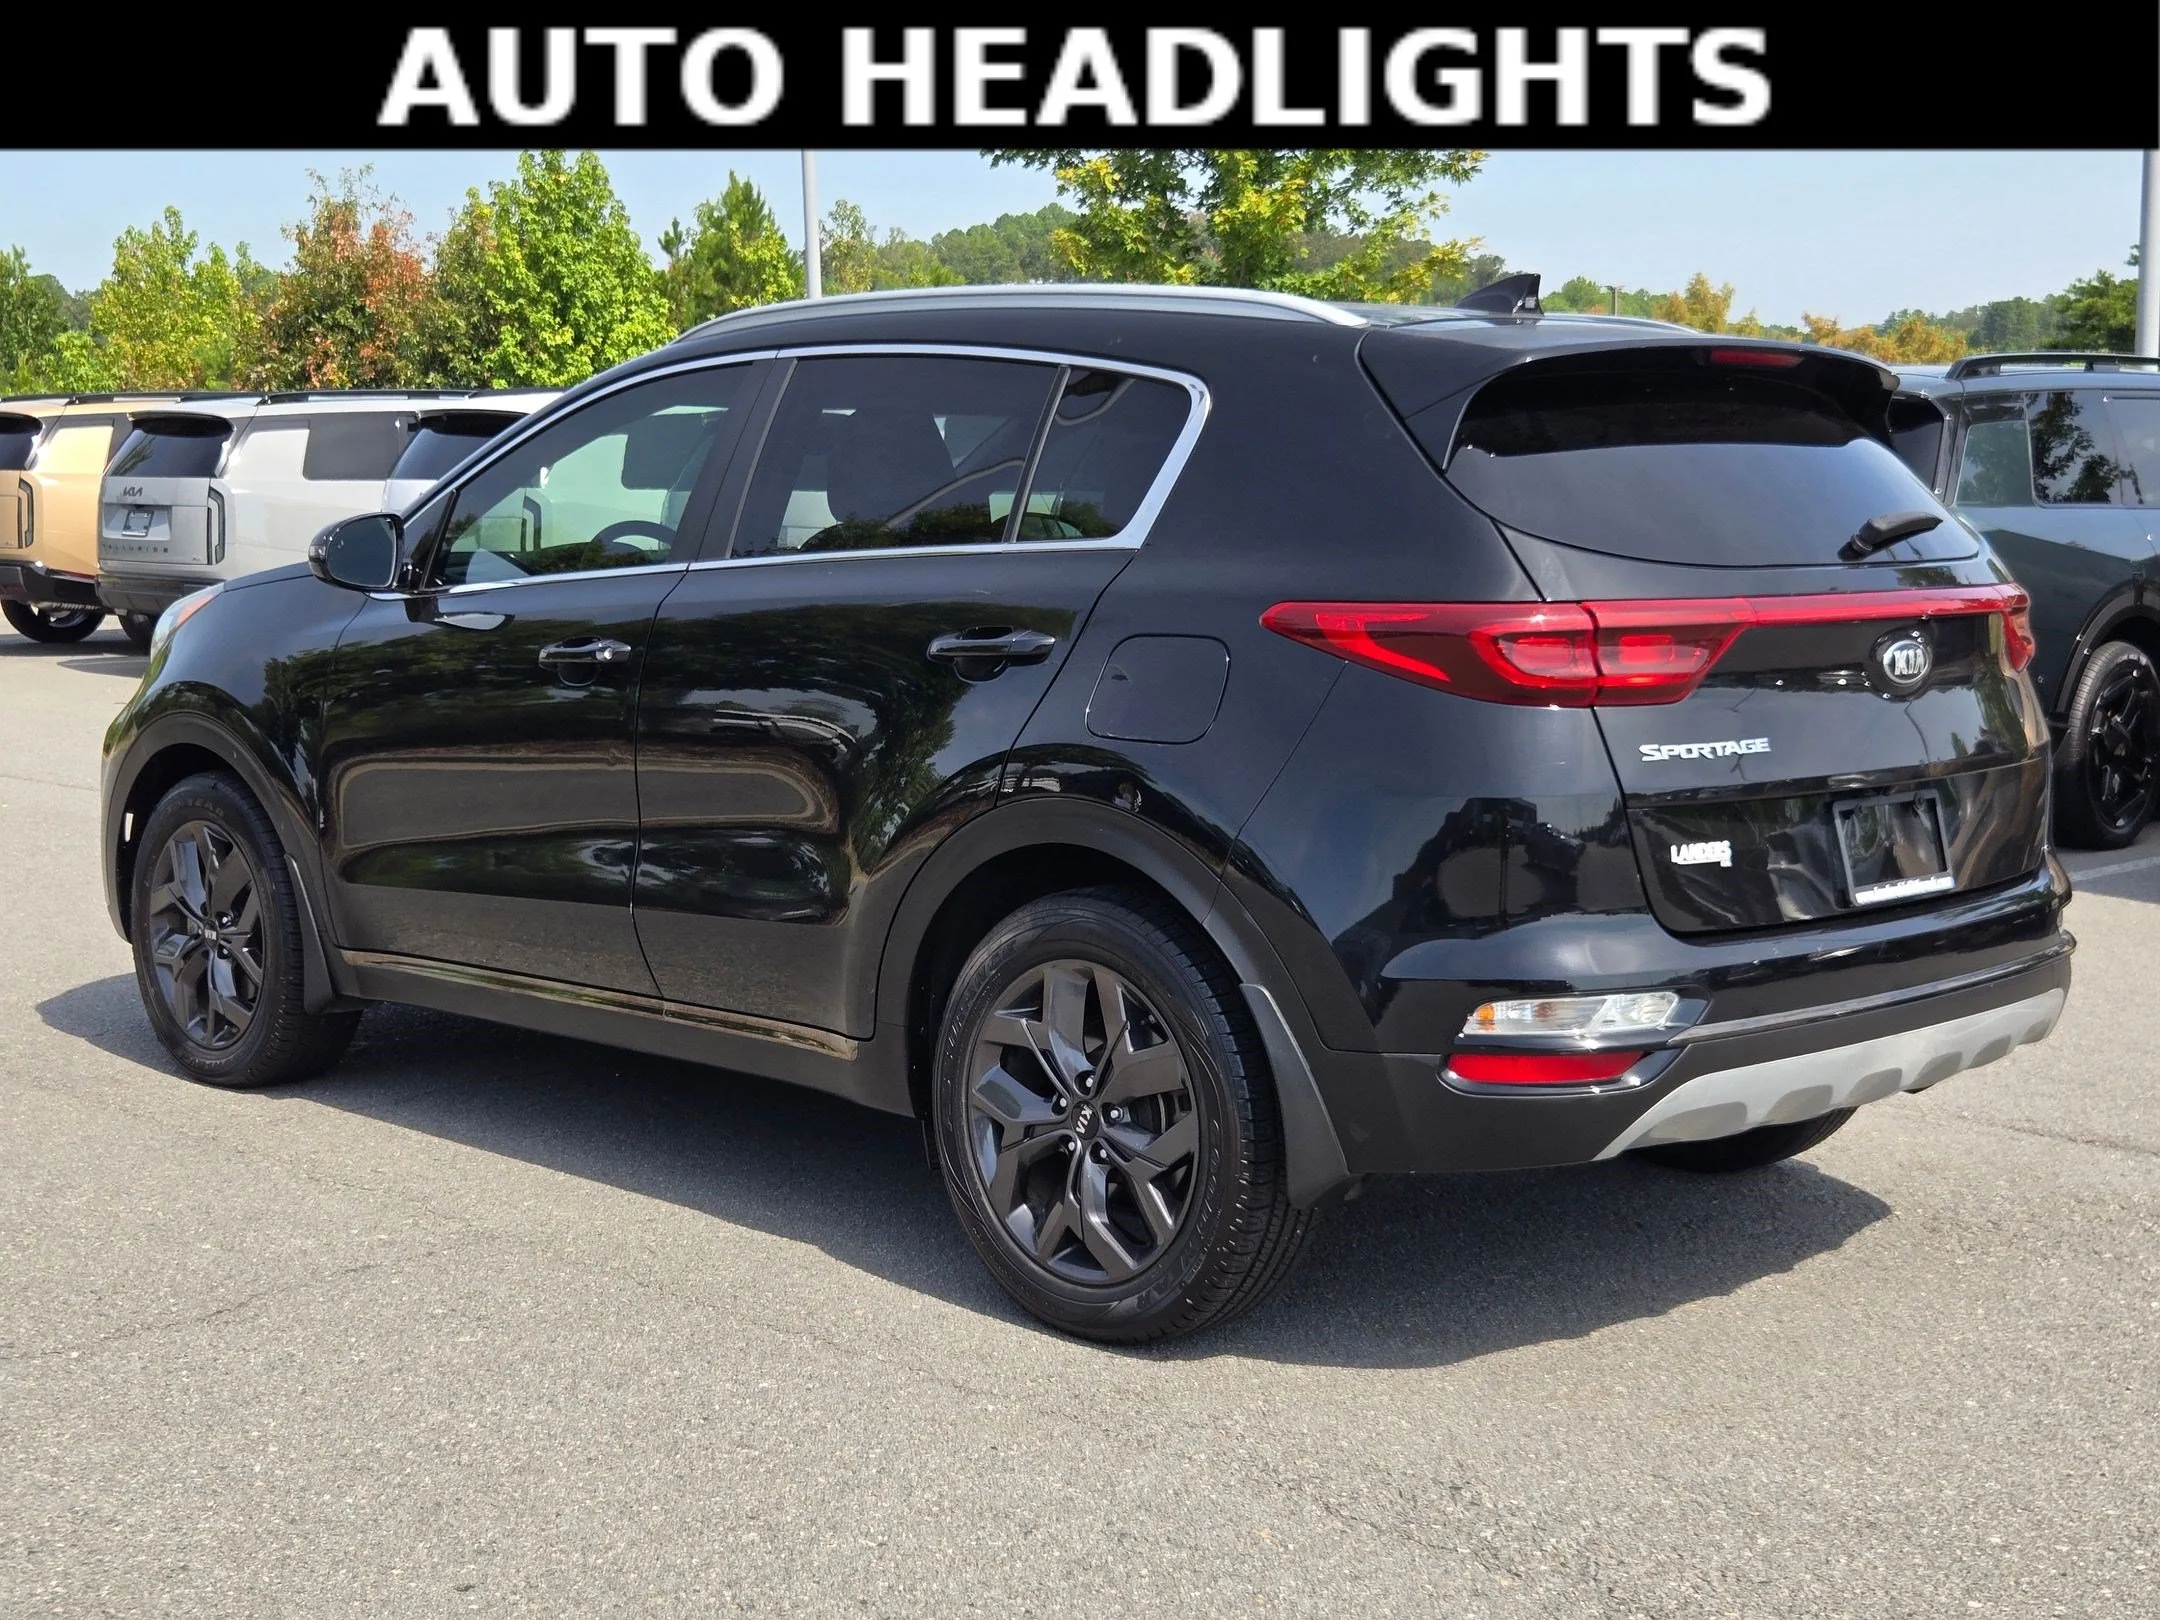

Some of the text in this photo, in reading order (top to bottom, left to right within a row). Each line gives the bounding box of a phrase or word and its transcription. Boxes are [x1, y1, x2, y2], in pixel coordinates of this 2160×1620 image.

[1893, 649, 1925, 675] KIA
[1639, 738, 1771, 762] SPORTAGE
[1075, 1104, 1093, 1134] KIA
